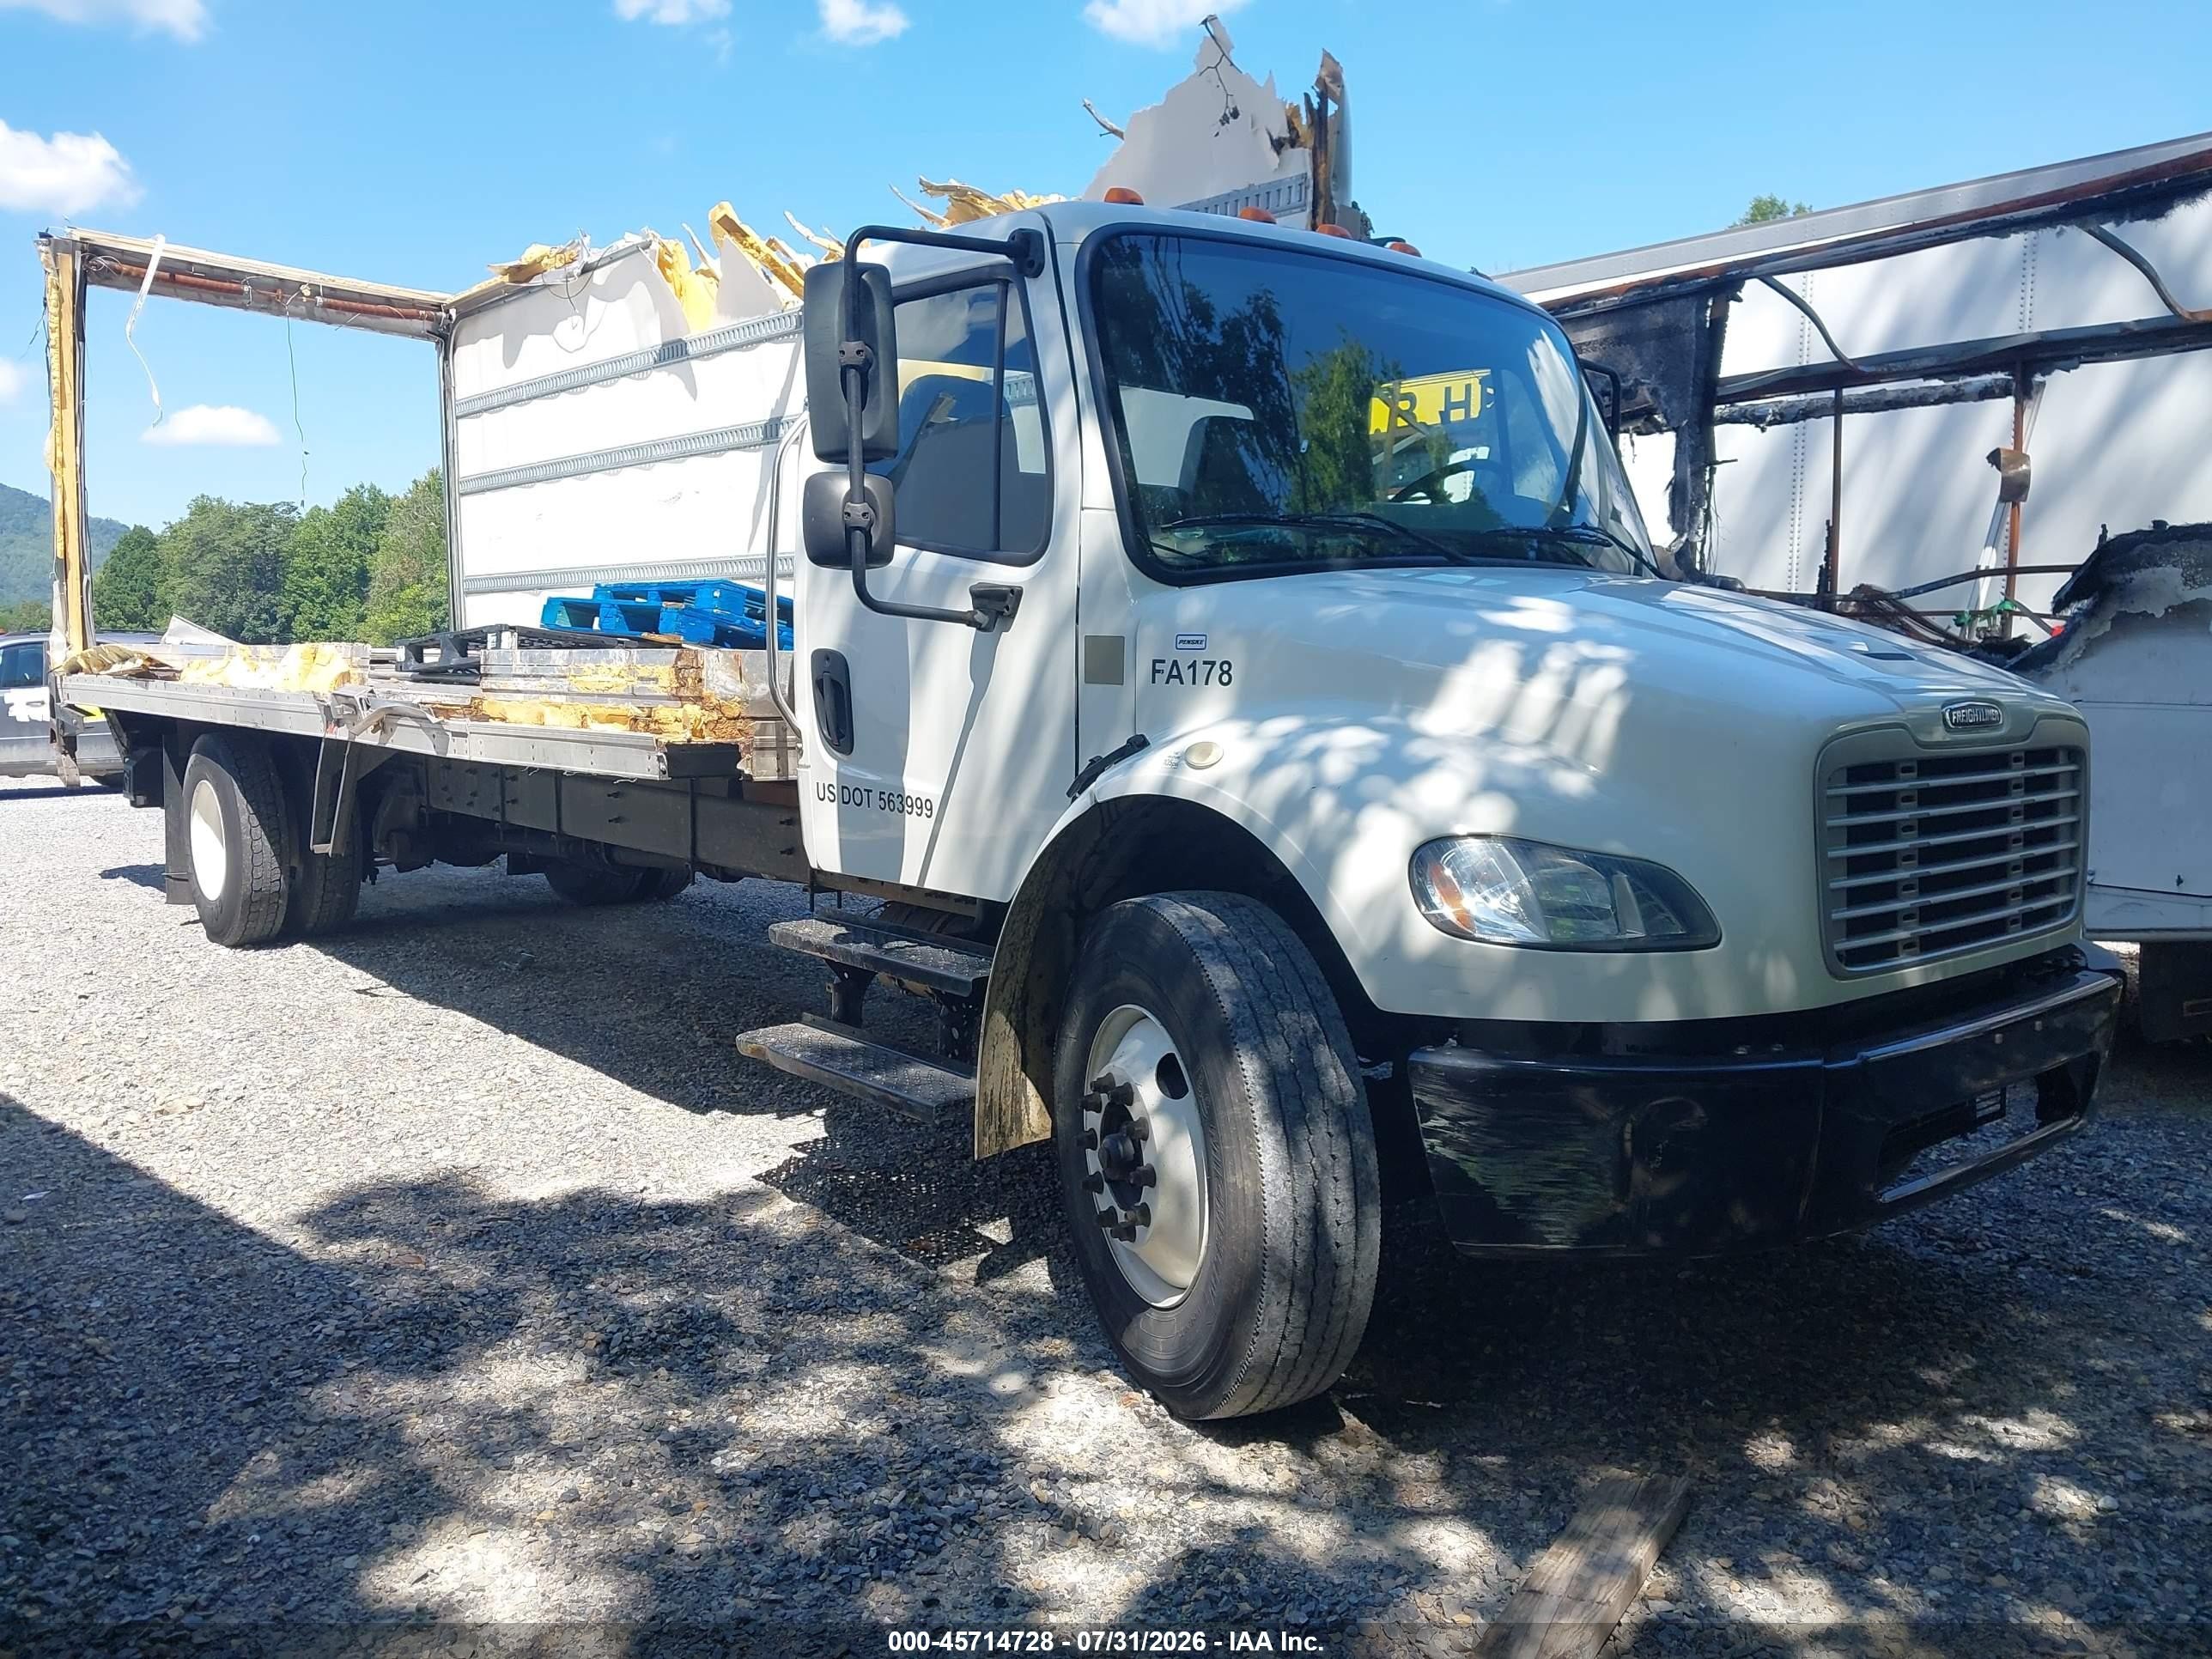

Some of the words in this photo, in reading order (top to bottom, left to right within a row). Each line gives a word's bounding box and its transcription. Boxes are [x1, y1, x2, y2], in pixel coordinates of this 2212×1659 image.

[1151, 659, 1233, 687] FA178
[1951, 707, 2001, 724] FREIGHTLINER
[816, 781, 836, 804] US
[841, 785, 873, 809] DOT
[878, 791, 933, 819] 563999
